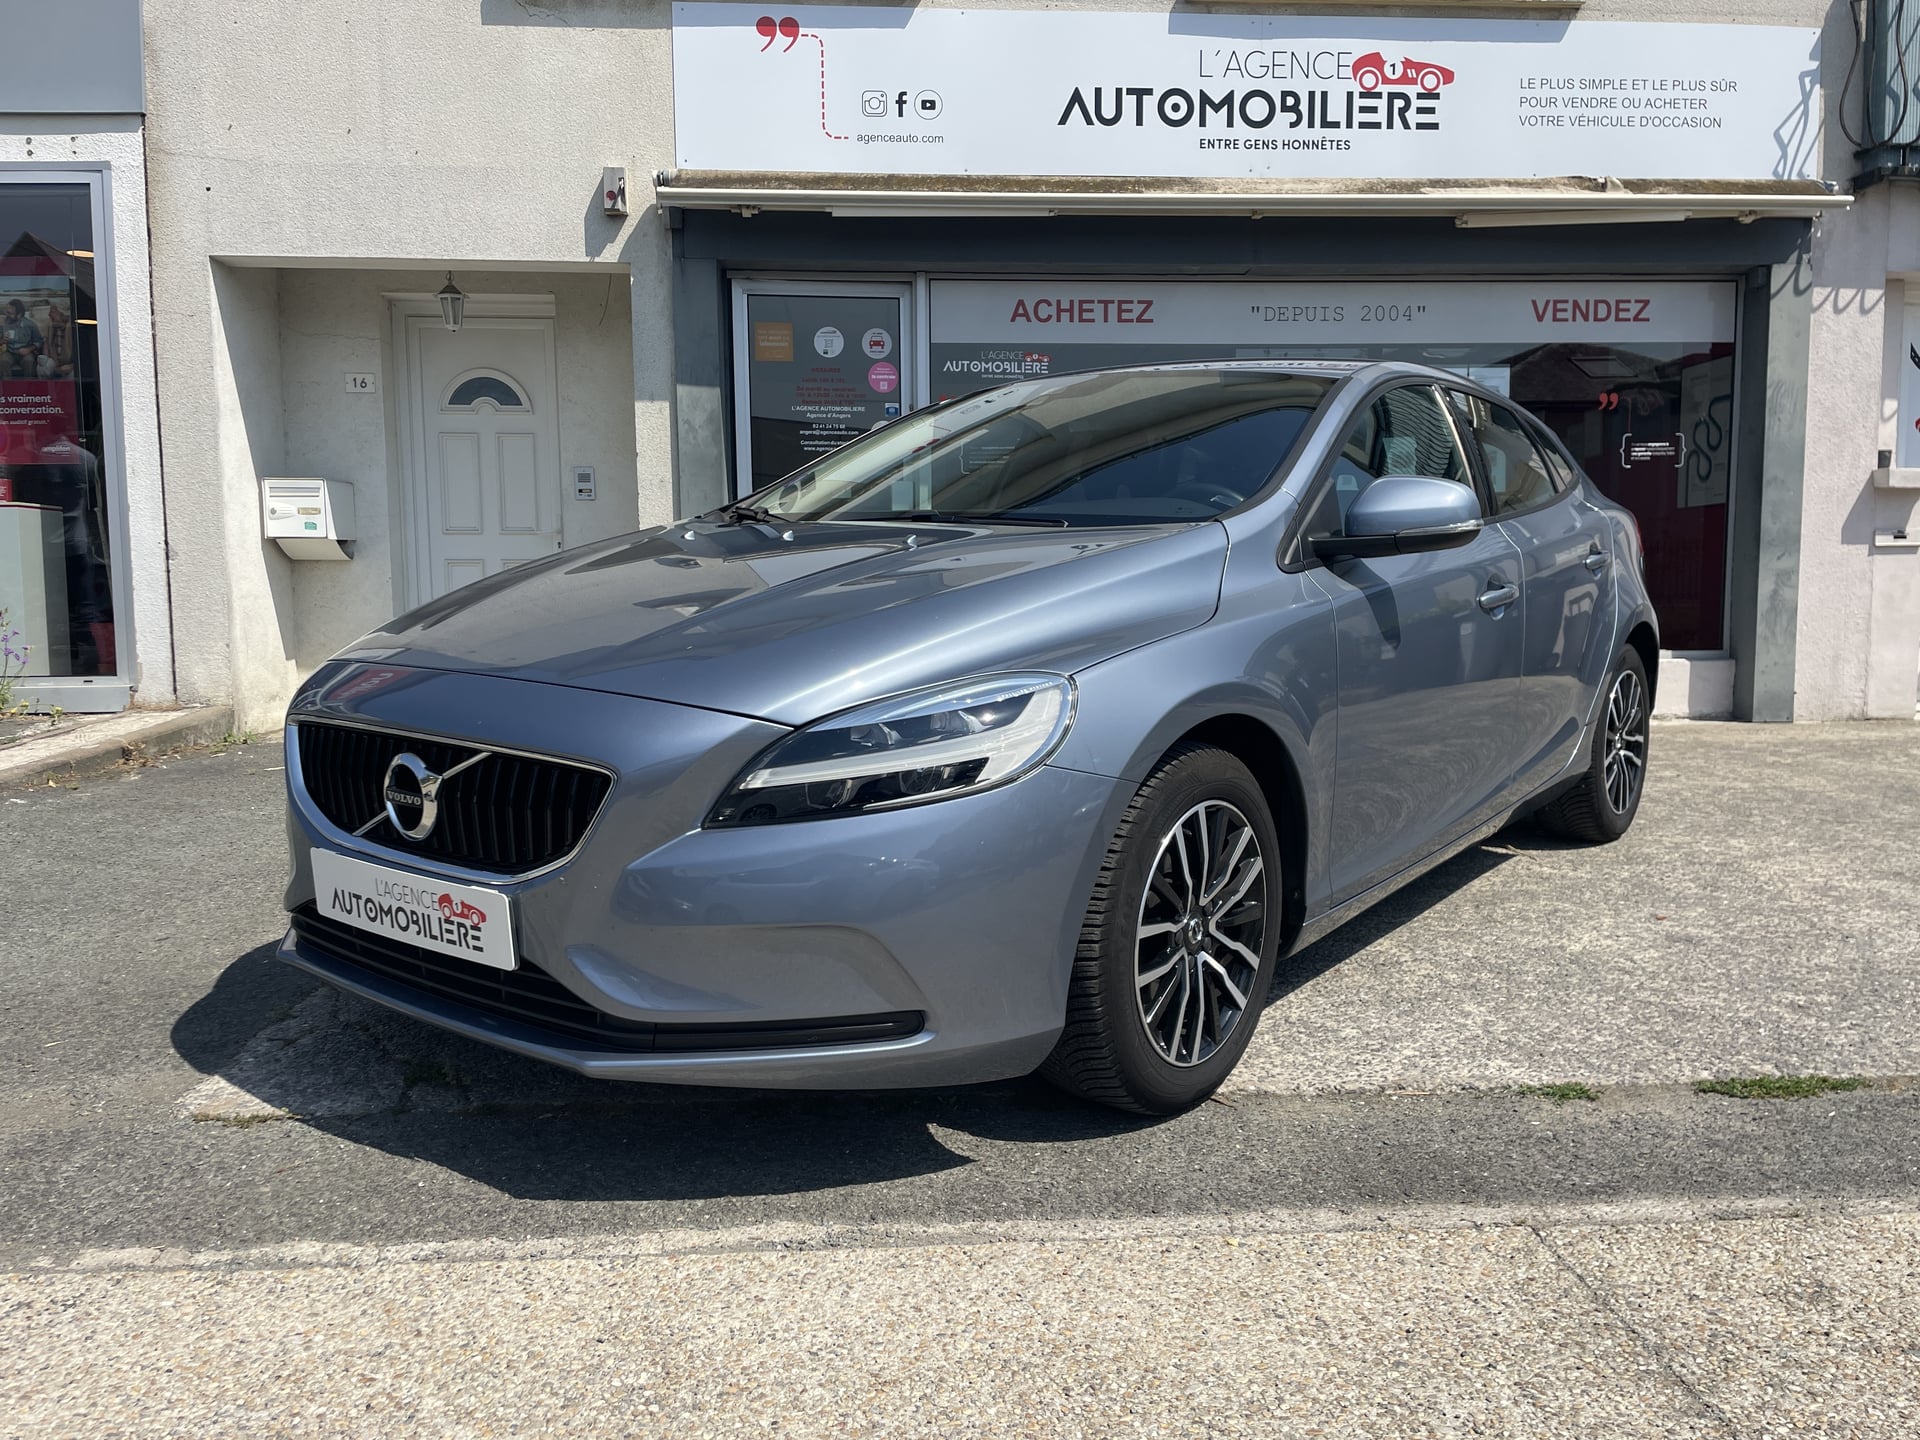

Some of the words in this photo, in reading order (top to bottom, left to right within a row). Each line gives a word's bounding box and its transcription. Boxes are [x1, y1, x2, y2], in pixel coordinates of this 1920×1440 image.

[1199, 49, 1352, 80] L'AGENCE
[1519, 78, 1536, 90] LE
[1540, 78, 1575, 90] PLUS
[1579, 78, 1627, 91] SIMPLE
[1632, 79, 1648, 91] ET
[1652, 79, 1668, 91] LE
[1672, 80, 1706, 92] PLUS
[1710, 77, 1738, 92] SÛR
[1519, 96, 1558, 109] POUR
[1562, 97, 1617, 109] VENDRE
[1621, 97, 1641, 109] OU
[1644, 97, 1708, 110] ACHETER
[1519, 115, 1564, 127] VOTRE
[1568, 112, 1636, 128] VÉHICULE
[1639, 115, 1722, 129] D'OCCASION
[856, 133, 944, 145] agenceauto.com
[1199, 138, 1240, 150] ENTRE
[1243, 138, 1278, 150] GENS
[1282, 136, 1351, 151] HONNÊTES
[1010, 298, 1154, 324] ACHETEZ
[1531, 298, 1651, 323] VENDEZ
[981, 351, 1024, 360] L'AGENCE
[353, 377, 367, 389] 16
[7, 394, 52, 403] vraiment
[0, 405, 65, 414] conversation.
[386, 790, 422, 806] VOLVO
[375, 877, 440, 912] L'AGENCE
